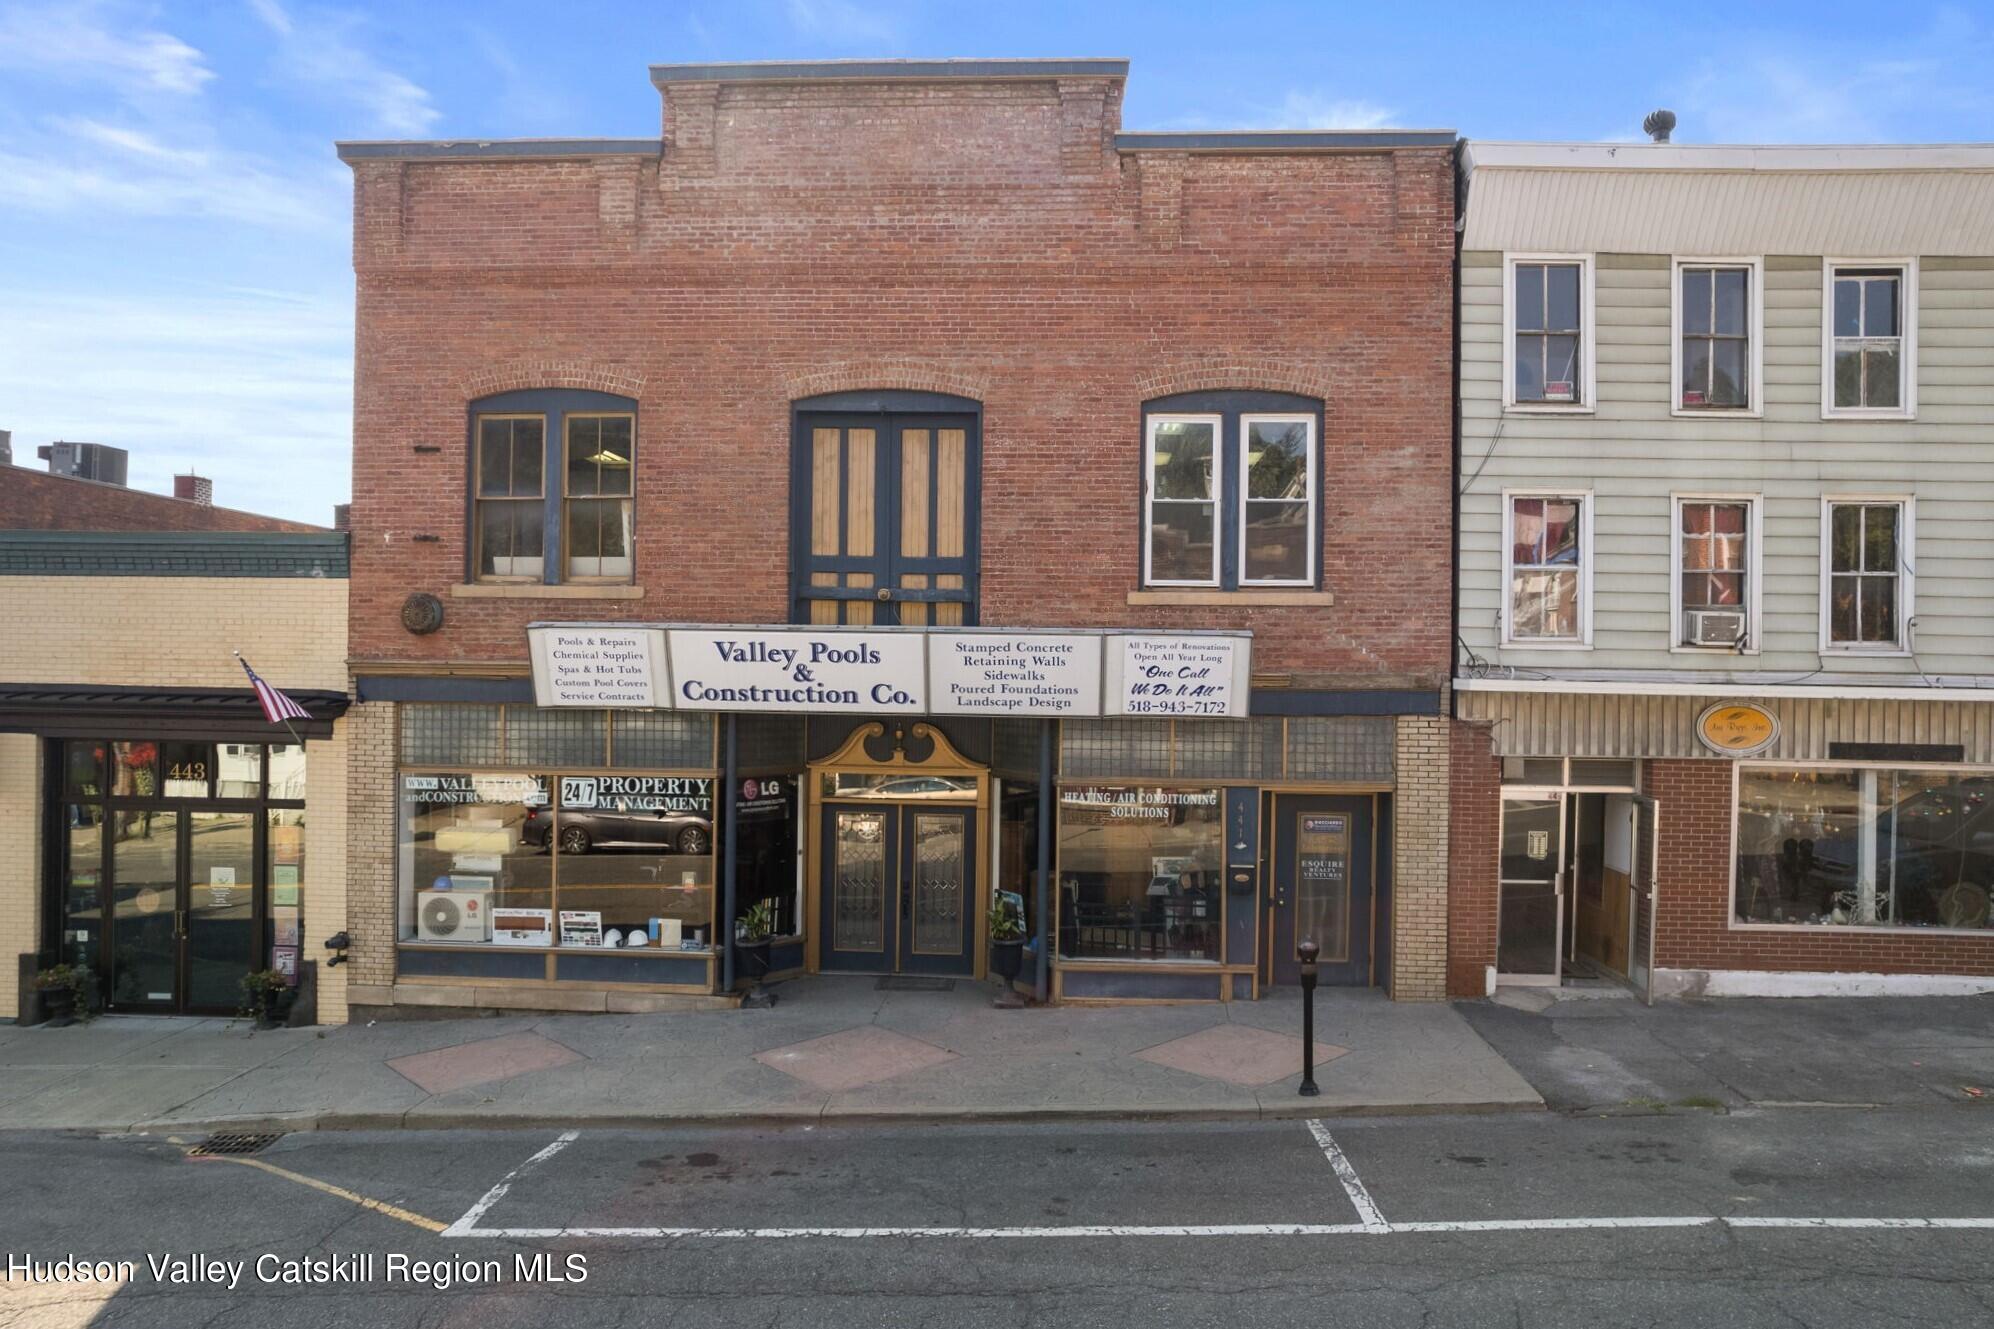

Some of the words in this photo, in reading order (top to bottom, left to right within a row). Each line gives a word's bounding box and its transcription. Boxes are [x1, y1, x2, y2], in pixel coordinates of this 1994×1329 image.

[558, 637, 583, 646] Pools
[587, 638, 594, 646] &
[600, 638, 636, 648] Repairs
[956, 642, 1011, 656] Stamped
[1016, 642, 1073, 653] Concrete
[1144, 642, 1167, 651] Types
[1170, 642, 1178, 650] of
[1182, 643, 1230, 651] Renovations
[553, 650, 599, 659] Chemical
[603, 651, 644, 662] Supplies
[713, 641, 799, 671] Valley
[809, 642, 881, 664] Pools
[964, 656, 1026, 669] Retaining
[1032, 656, 1066, 666] Walls
[1134, 653, 1158, 662] Open
[1200, 654, 1223, 664] Long
[558, 665, 580, 676] Spas
[584, 665, 591, 673] &
[596, 665, 614, 673] Hot
[617, 665, 642, 673] Tubs
[793, 663, 816, 682] &
[984, 670, 1045, 681] Sidewalks
[1178, 666, 1210, 679] Call
[555, 678, 590, 686] Custom
[594, 679, 614, 687] Pool
[616, 679, 648, 687] Covers
[951, 683, 995, 694] Poured
[1000, 684, 1079, 695] Foundations
[560, 692, 594, 700] Service
[598, 692, 645, 700] Contracts
[682, 680, 860, 704] Construction
[870, 684, 917, 704] Co.
[1131, 683, 1150, 695] We
[1152, 683, 1172, 696] Do
[1176, 684, 1188, 696] It
[958, 696, 1023, 710] Landscape
[1029, 697, 1071, 710] Design
[1127, 700, 1226, 714] 518-943-7172
[170, 762, 205, 780] 443
[598, 777, 710, 795] PROPERTY
[761, 781, 779, 796] LG
[564, 783, 595, 803] 24/7
[1139, 793, 1217, 805] CONDITIONING
[598, 796, 710, 811] MANAGEMENT
[1110, 806, 1169, 818] SOLUTIONS
[1302, 860, 1344, 868] ESQUIRE
